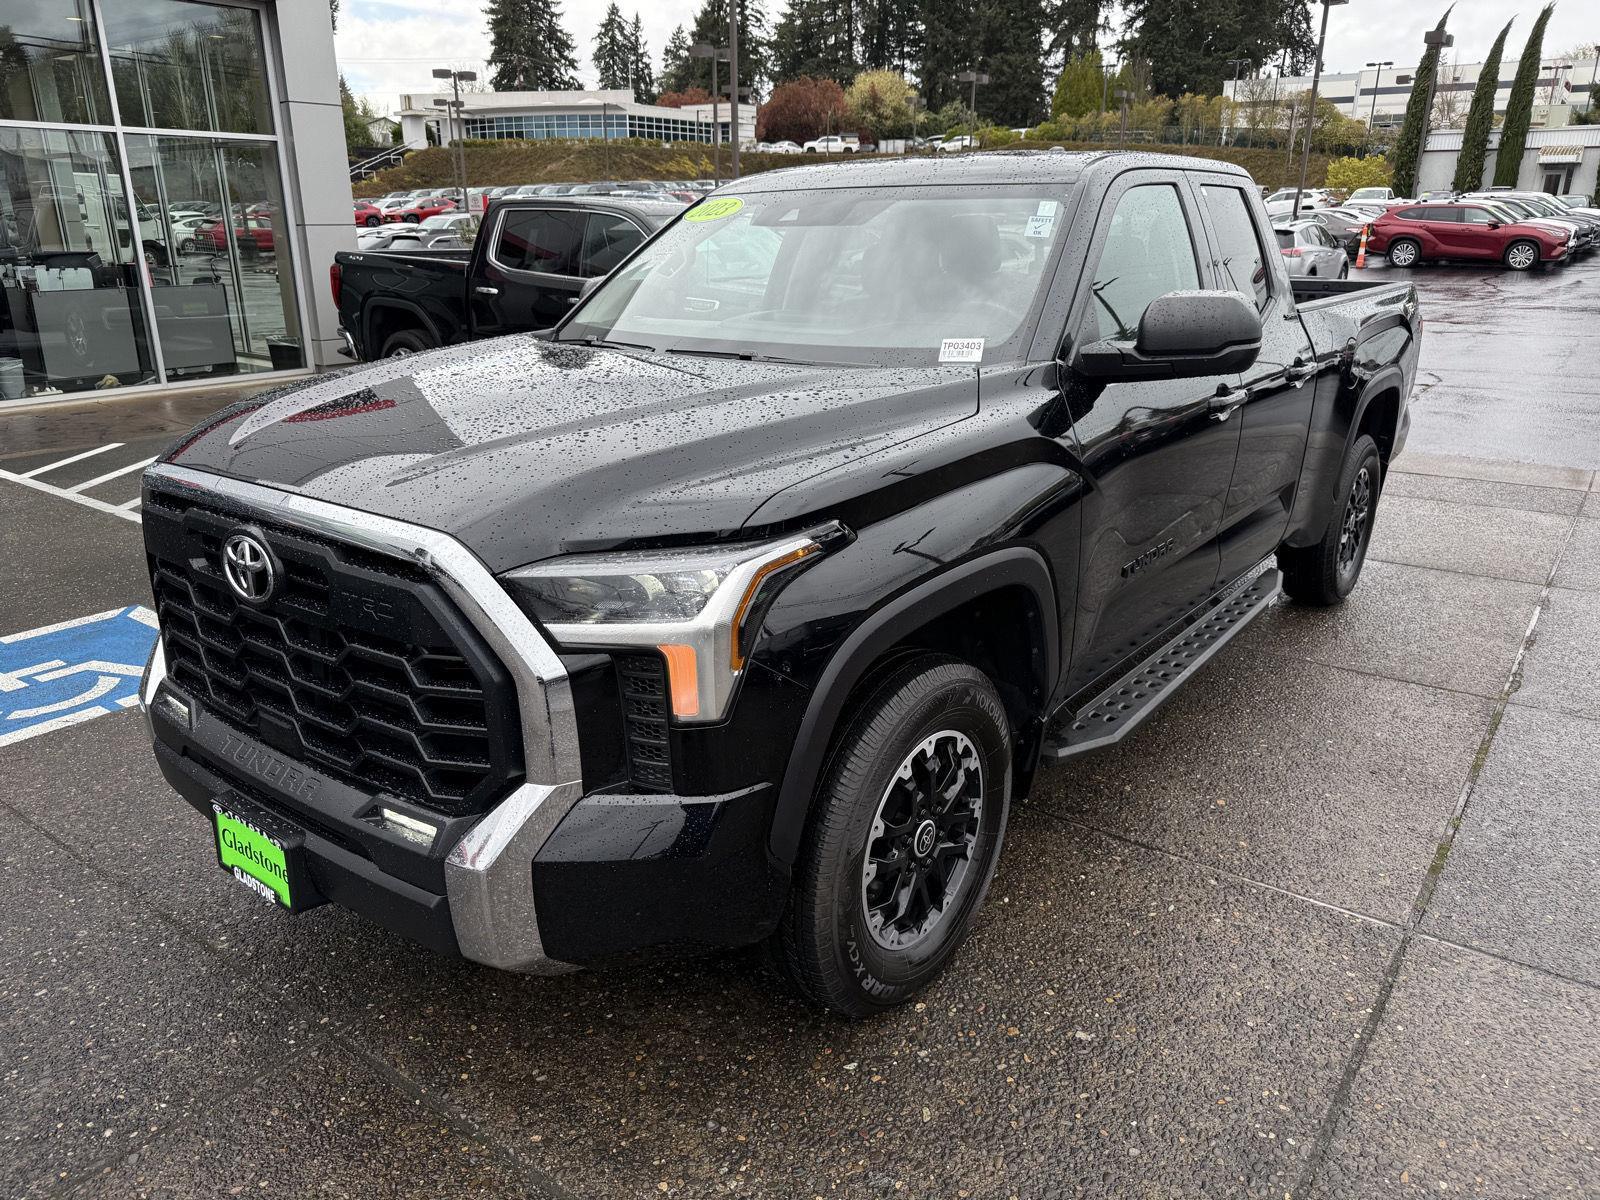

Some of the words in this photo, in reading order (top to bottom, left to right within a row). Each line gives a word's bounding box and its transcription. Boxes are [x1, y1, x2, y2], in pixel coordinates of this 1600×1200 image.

[975, 689, 1009, 750] YOKOHAMA
[220, 733, 324, 802] TUNDRA
[221, 828, 288, 884] Gladstone
[233, 866, 276, 904] GLADSTONE
